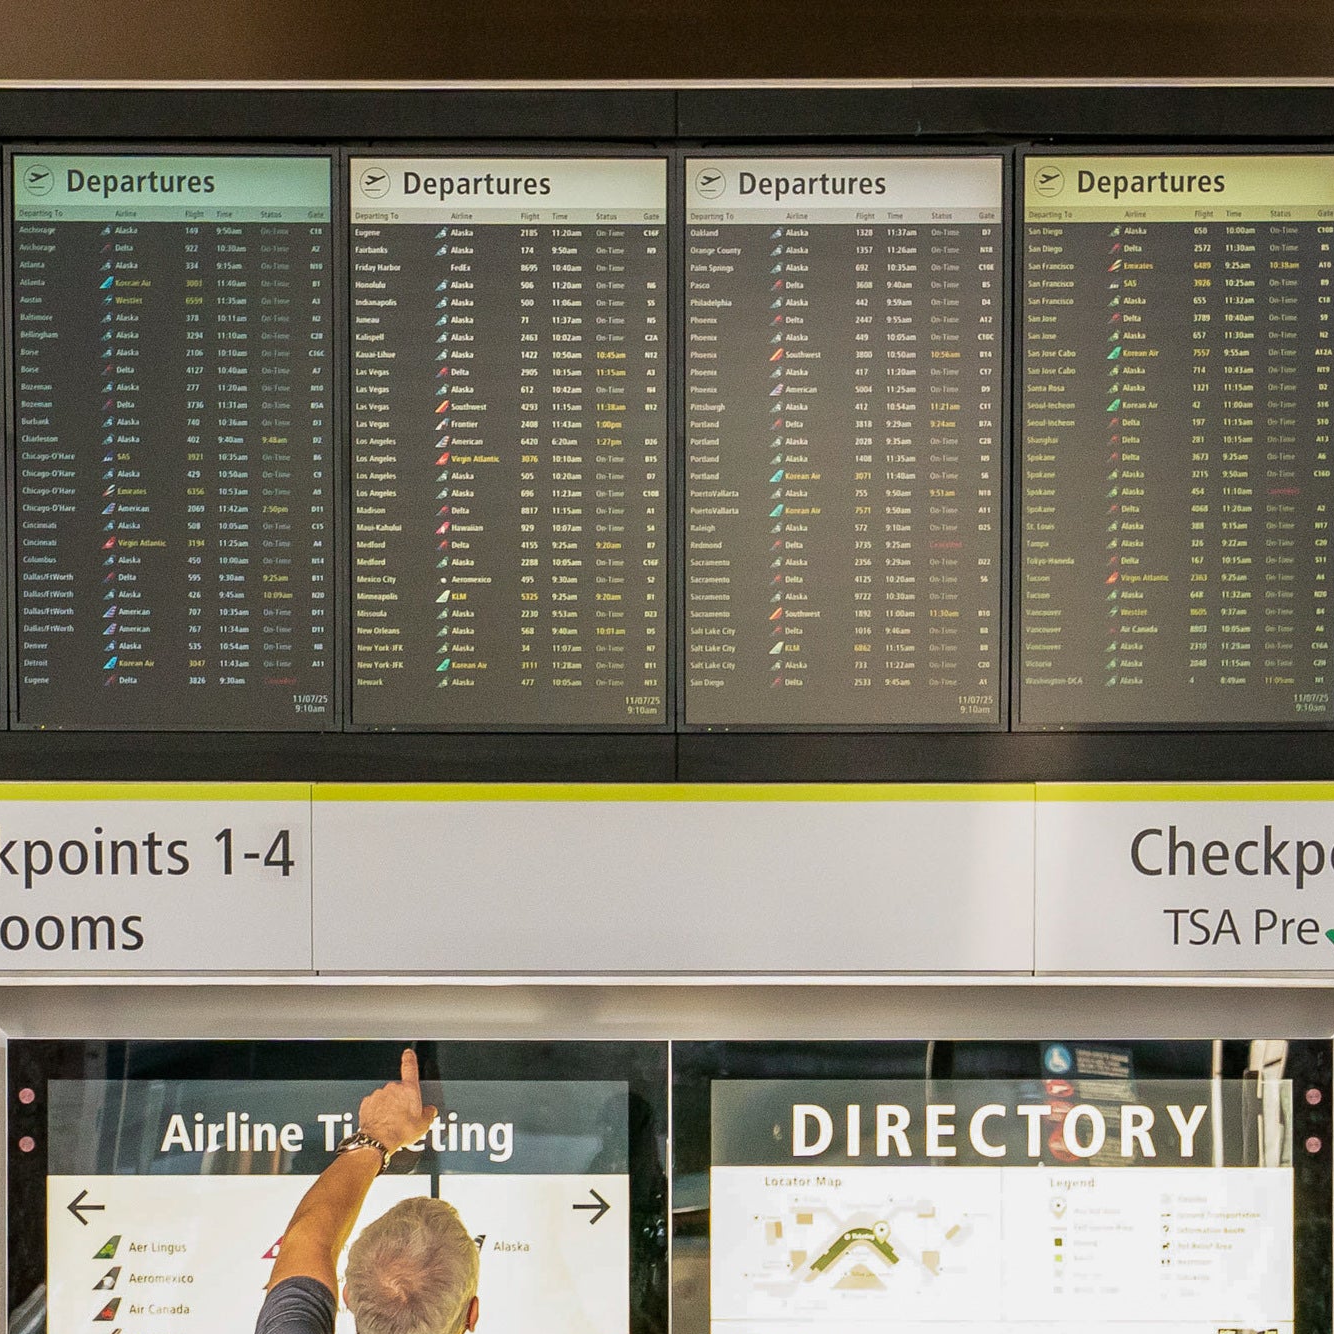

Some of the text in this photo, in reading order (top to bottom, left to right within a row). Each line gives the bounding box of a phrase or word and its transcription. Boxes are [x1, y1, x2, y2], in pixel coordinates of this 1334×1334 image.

[67, 170, 215, 199] Departures
[403, 171, 551, 200] Departures
[738, 172, 886, 200] Departures
[1077, 170, 1225, 197] Departures
[355, 229, 380, 238] Eugene
[215, 829, 295, 876] 1-4
[1164, 909, 1240, 945] TSA
[161, 1112, 514, 1163] Airline Titing
[792, 1104, 1208, 1158] DIRECTORY
[765, 1176, 842, 1188] Locator Map
[1050, 1178, 1094, 1190] Legend
[129, 1243, 186, 1254] Aer Lingus
[493, 1241, 530, 1252] Alaska
[129, 1274, 194, 1283] Aeromexico
[129, 1305, 189, 1314] Air Canada
